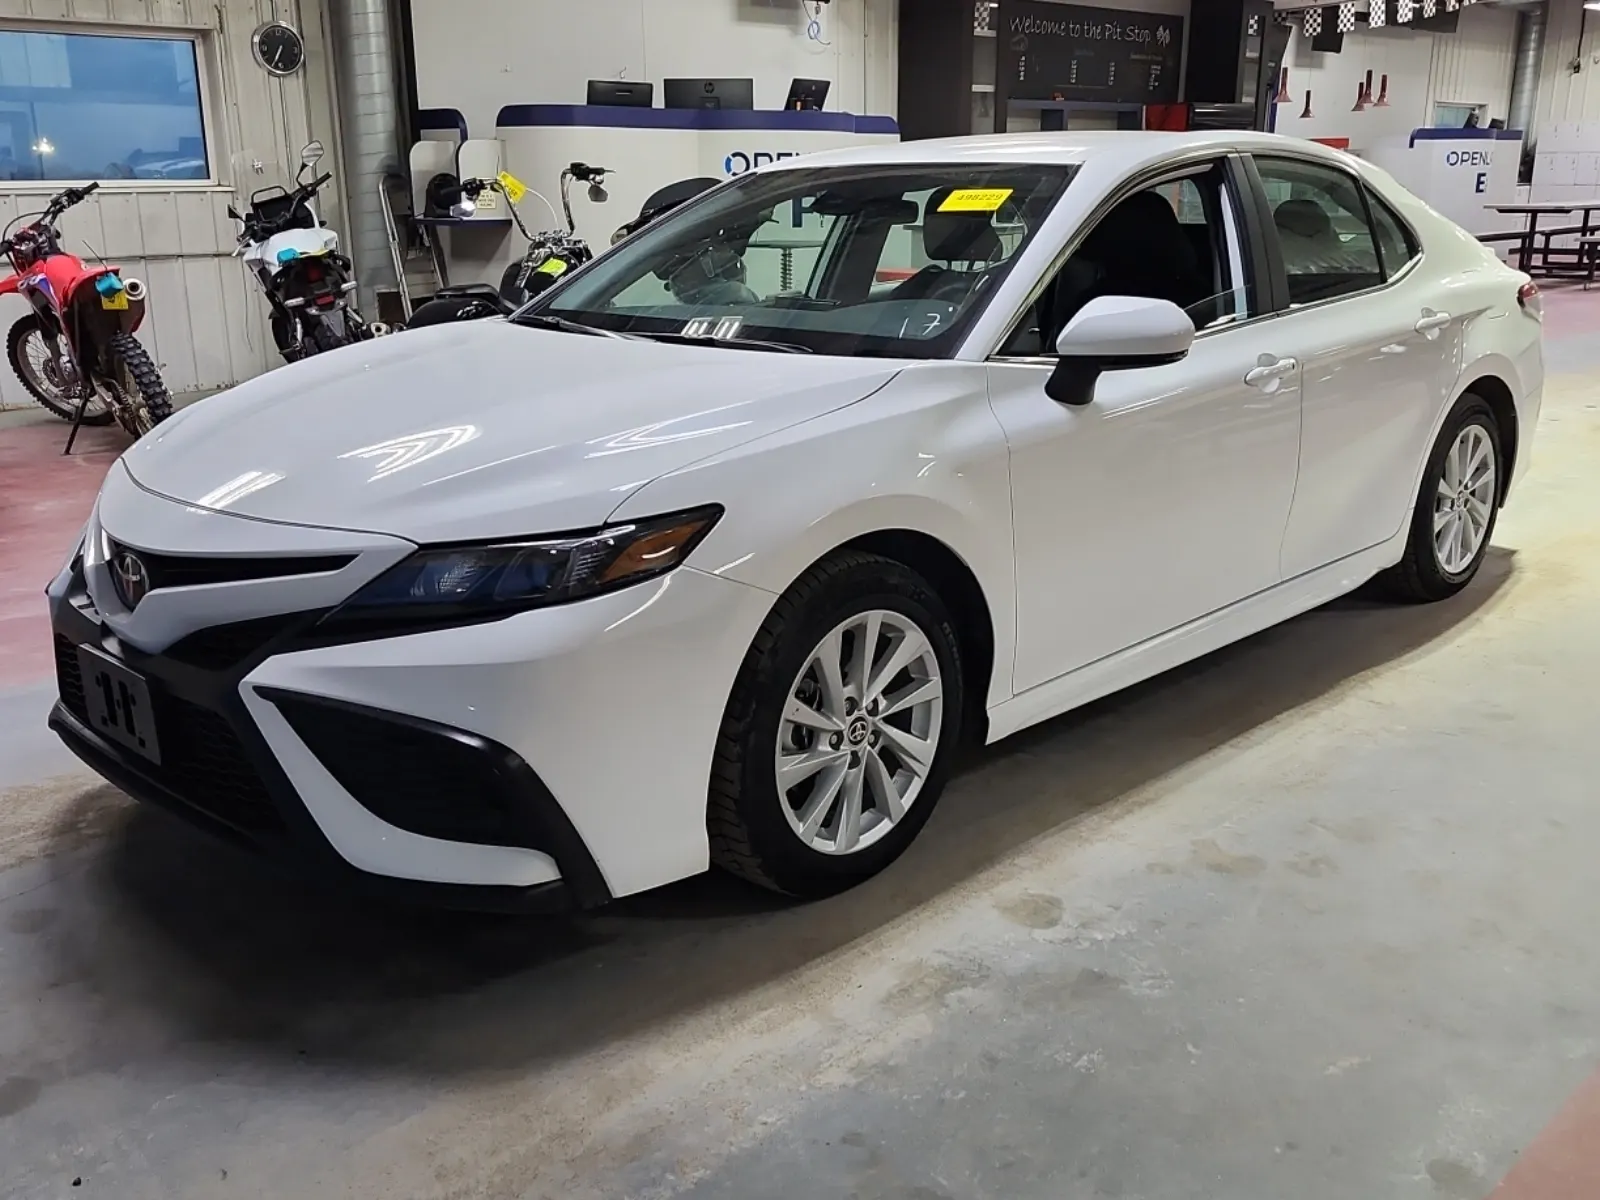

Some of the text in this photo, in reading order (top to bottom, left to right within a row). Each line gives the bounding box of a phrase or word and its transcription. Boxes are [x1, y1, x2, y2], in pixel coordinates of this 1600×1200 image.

[1010, 15, 1152, 50] Welcome to the Pit Stop
[1446, 151, 1493, 166] OPENL
